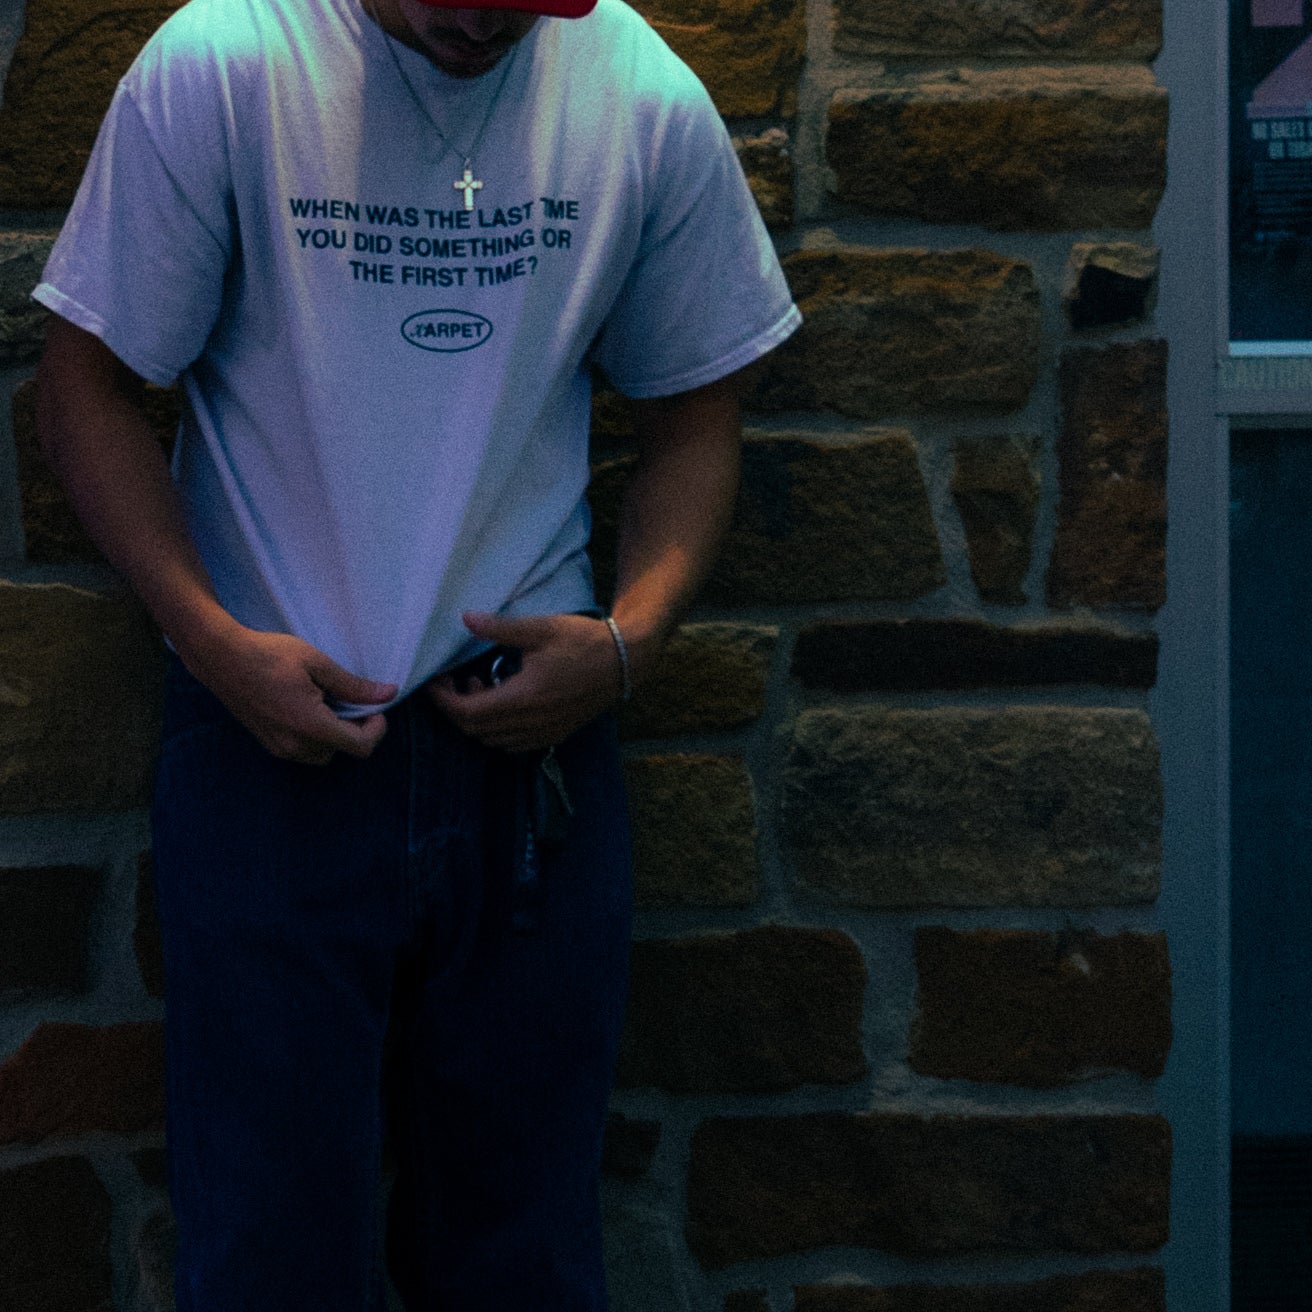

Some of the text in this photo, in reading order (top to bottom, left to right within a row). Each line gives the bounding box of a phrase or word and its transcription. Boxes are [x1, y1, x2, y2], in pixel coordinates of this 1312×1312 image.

[289, 196, 580, 229] WHEN WAS THE LAST TME
[296, 228, 572, 258] YOU DID SOMETHING OR
[348, 255, 539, 287] THE FIRST TIME?
